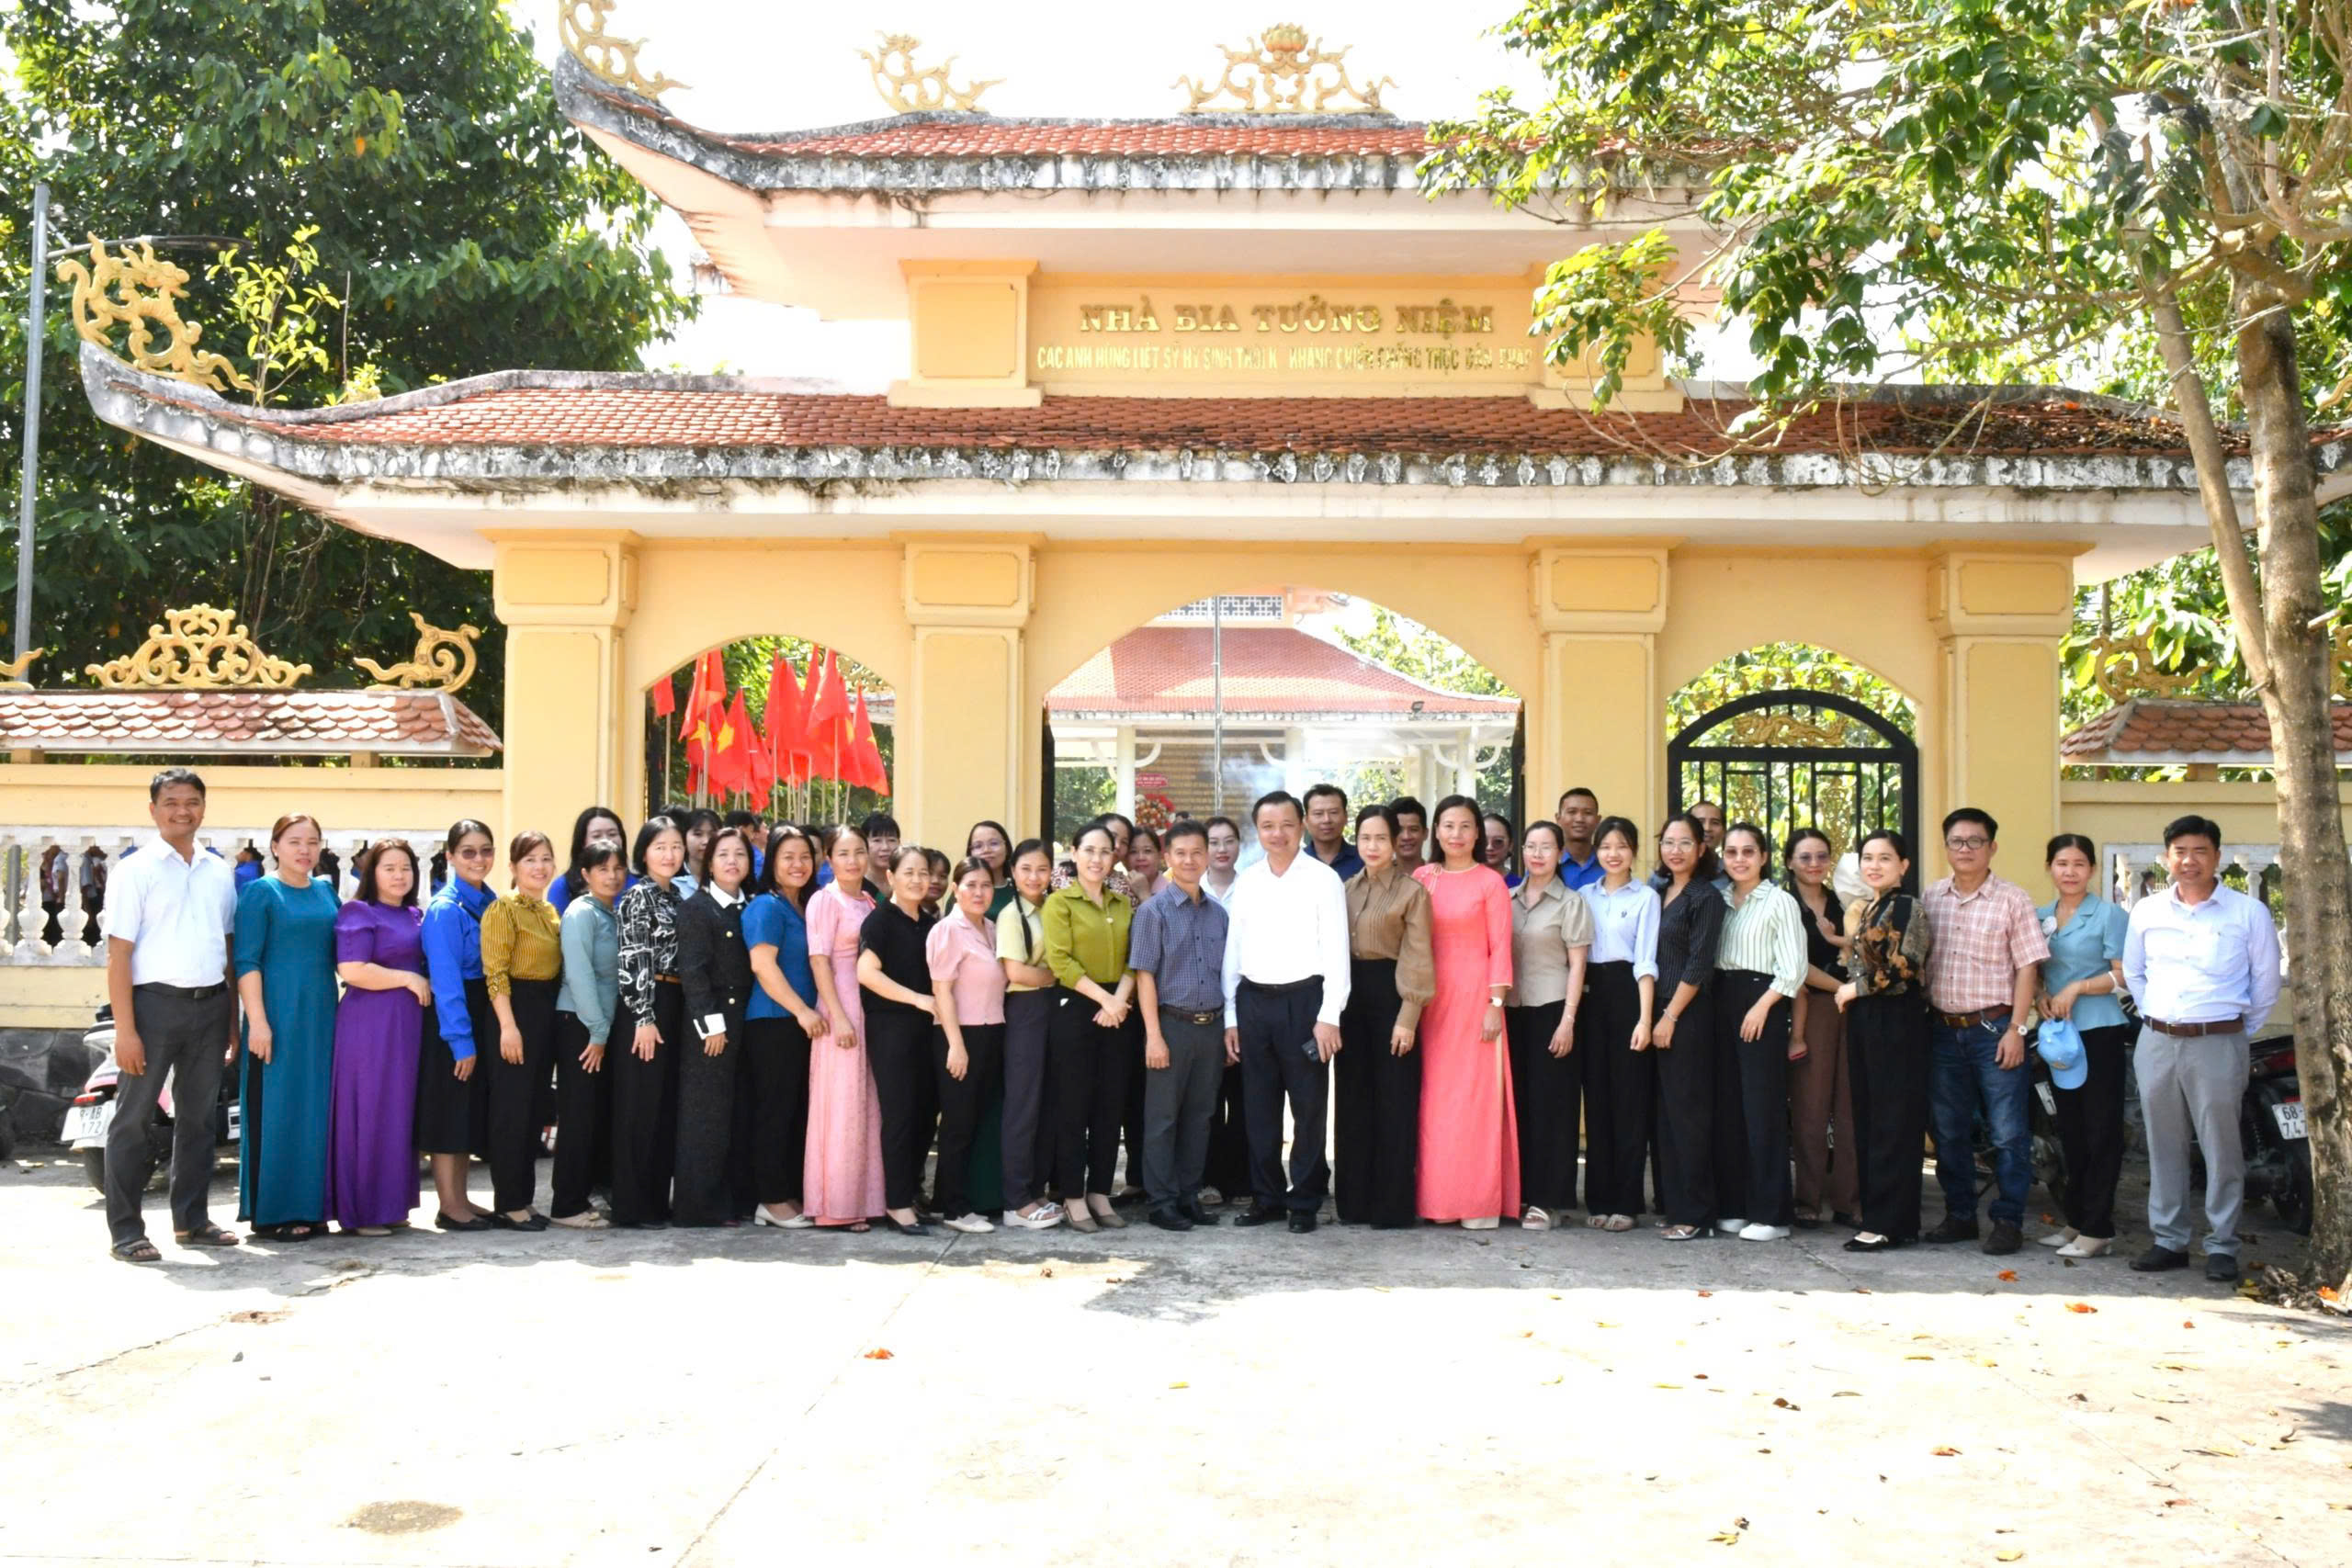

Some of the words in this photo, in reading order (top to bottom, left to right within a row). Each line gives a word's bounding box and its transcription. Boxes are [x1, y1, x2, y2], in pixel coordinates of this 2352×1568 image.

[1080, 294, 1160, 333] NHÀ
[1174, 304, 1239, 333] BIA
[1251, 294, 1381, 333] TƯỞNG
[1396, 299, 1493, 339] NIỆM
[1065, 345, 1091, 368] ANH
